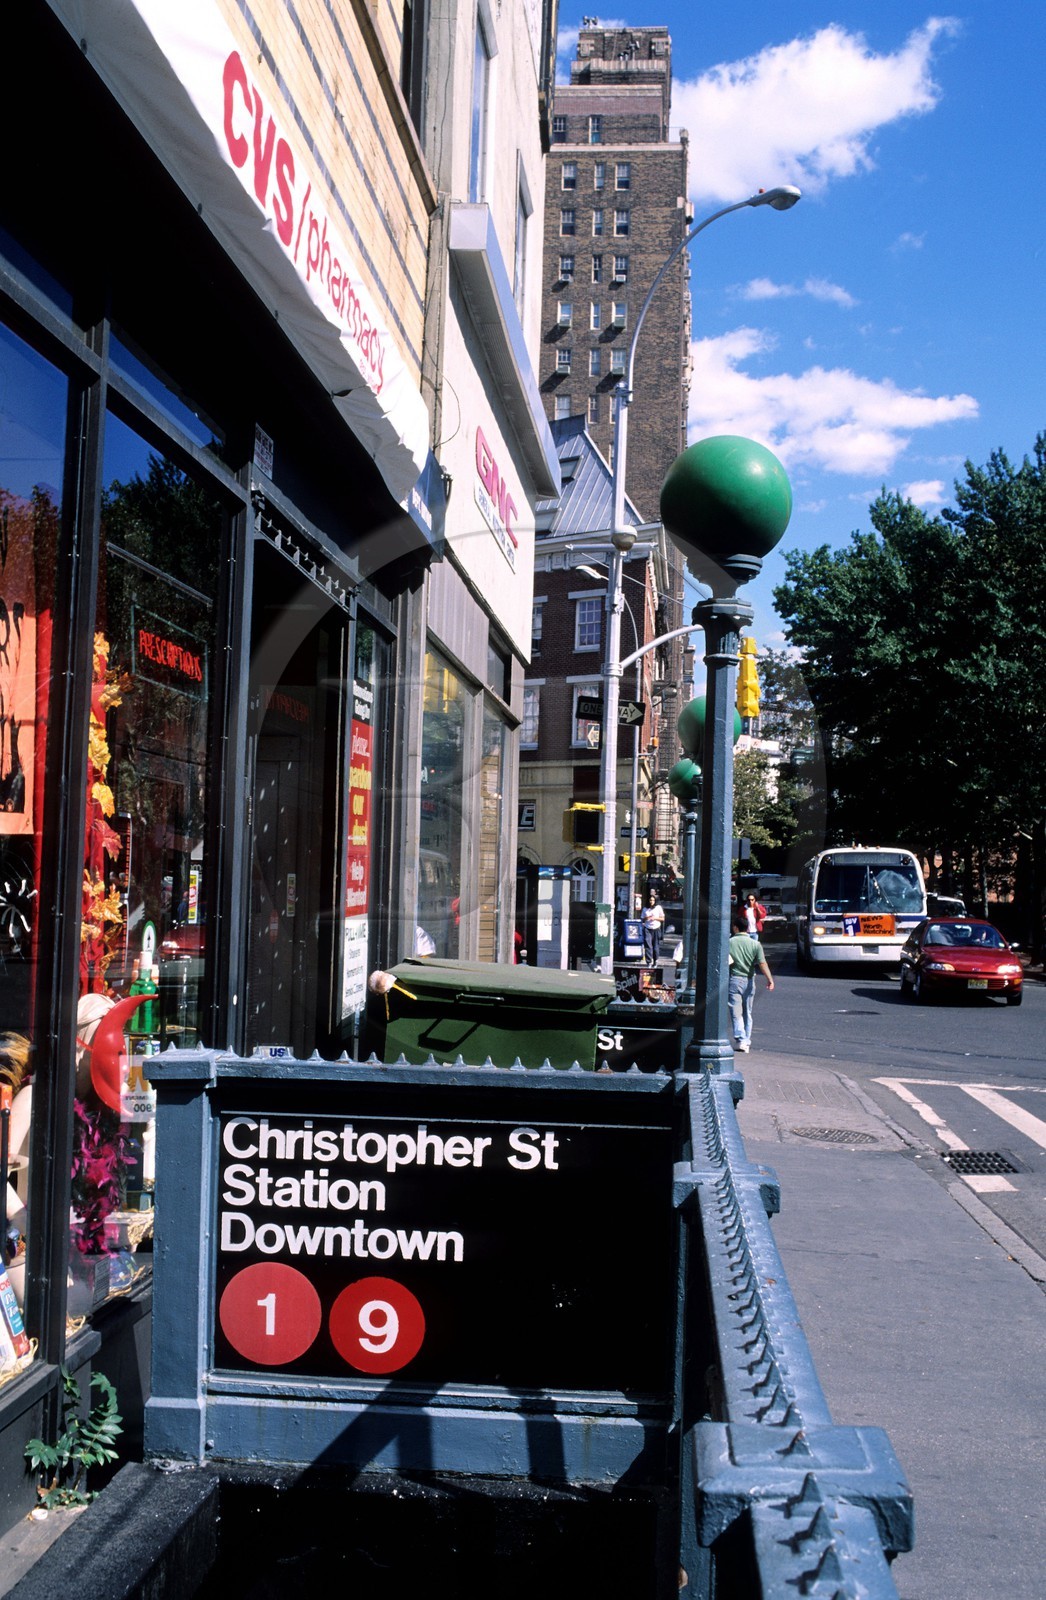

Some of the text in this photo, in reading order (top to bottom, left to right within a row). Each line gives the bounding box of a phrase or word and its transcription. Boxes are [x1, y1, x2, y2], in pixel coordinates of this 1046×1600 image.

[475, 425, 518, 549] GNC
[352, 794, 365, 815] our
[616, 974, 637, 991] Spirit
[597, 1029, 624, 1051] St
[222, 1116, 559, 1173] Christopher St
[222, 1164, 386, 1211] Station
[220, 1211, 464, 1262] Downtown
[257, 1293, 400, 1354] 1 9
